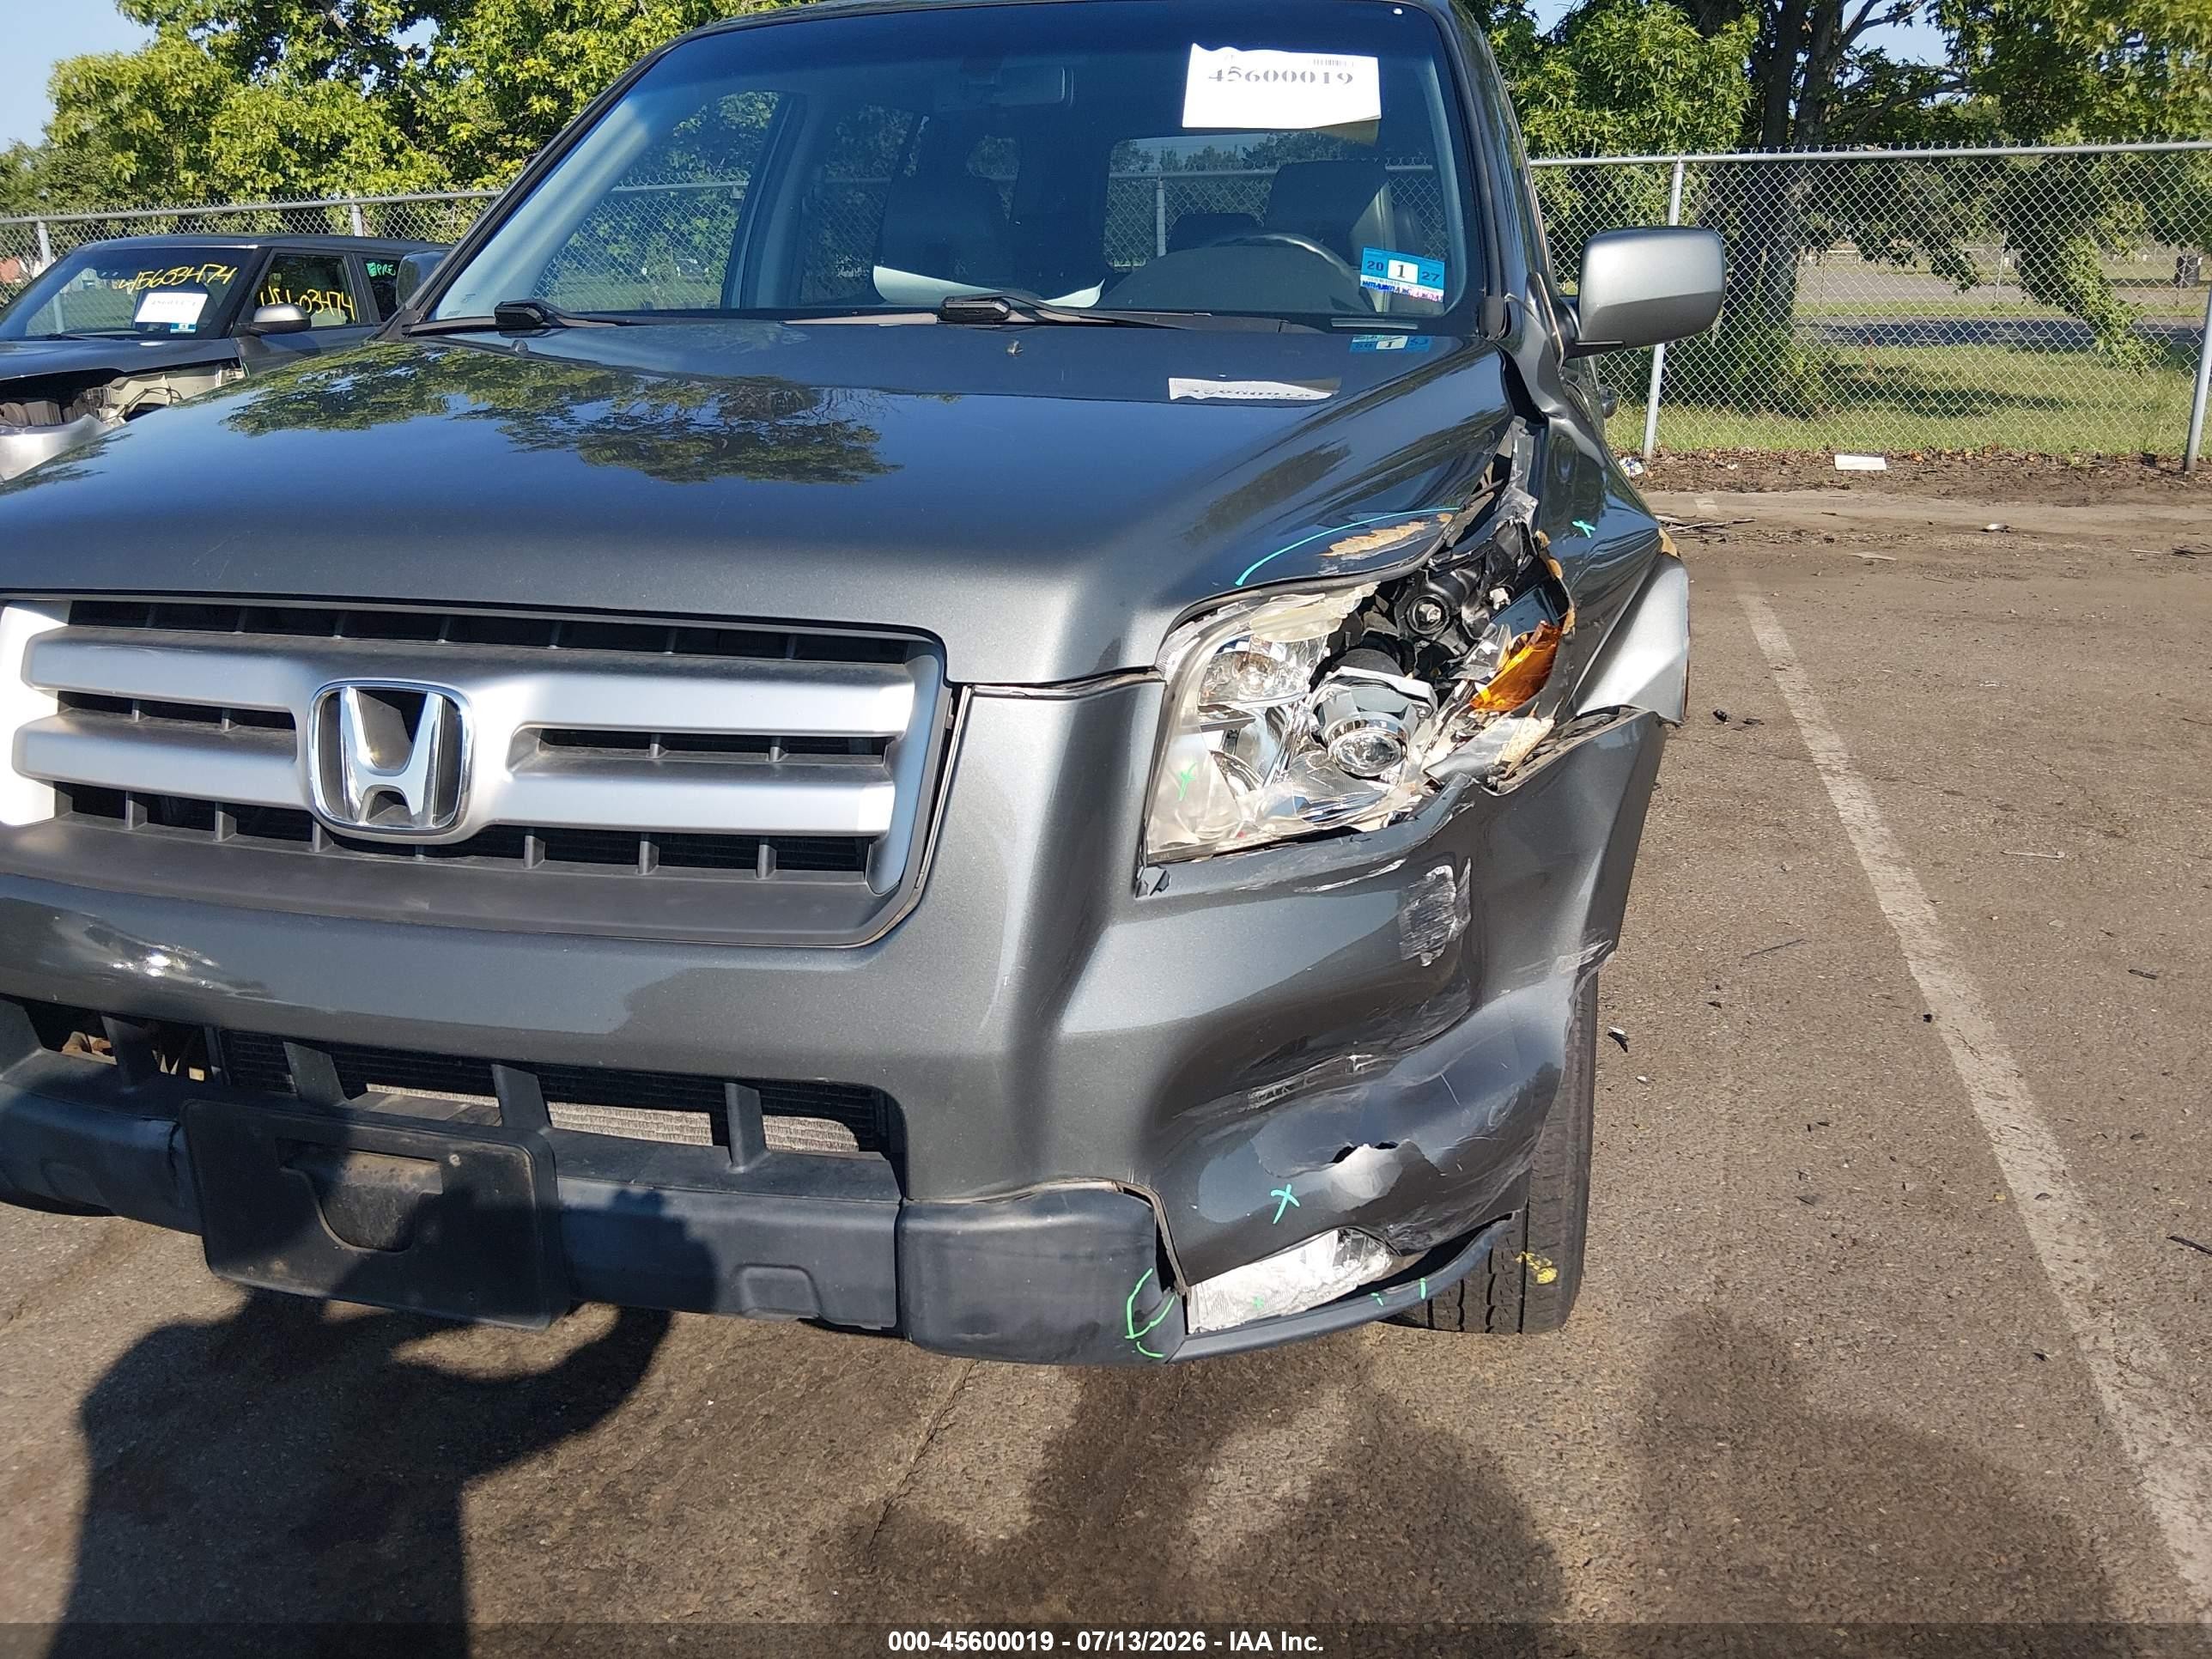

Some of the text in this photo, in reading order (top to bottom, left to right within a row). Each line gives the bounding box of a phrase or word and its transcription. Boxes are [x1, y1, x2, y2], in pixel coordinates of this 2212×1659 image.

[1208, 66, 1354, 85] 45600019
[1367, 260, 1441, 283] 20 1 27
